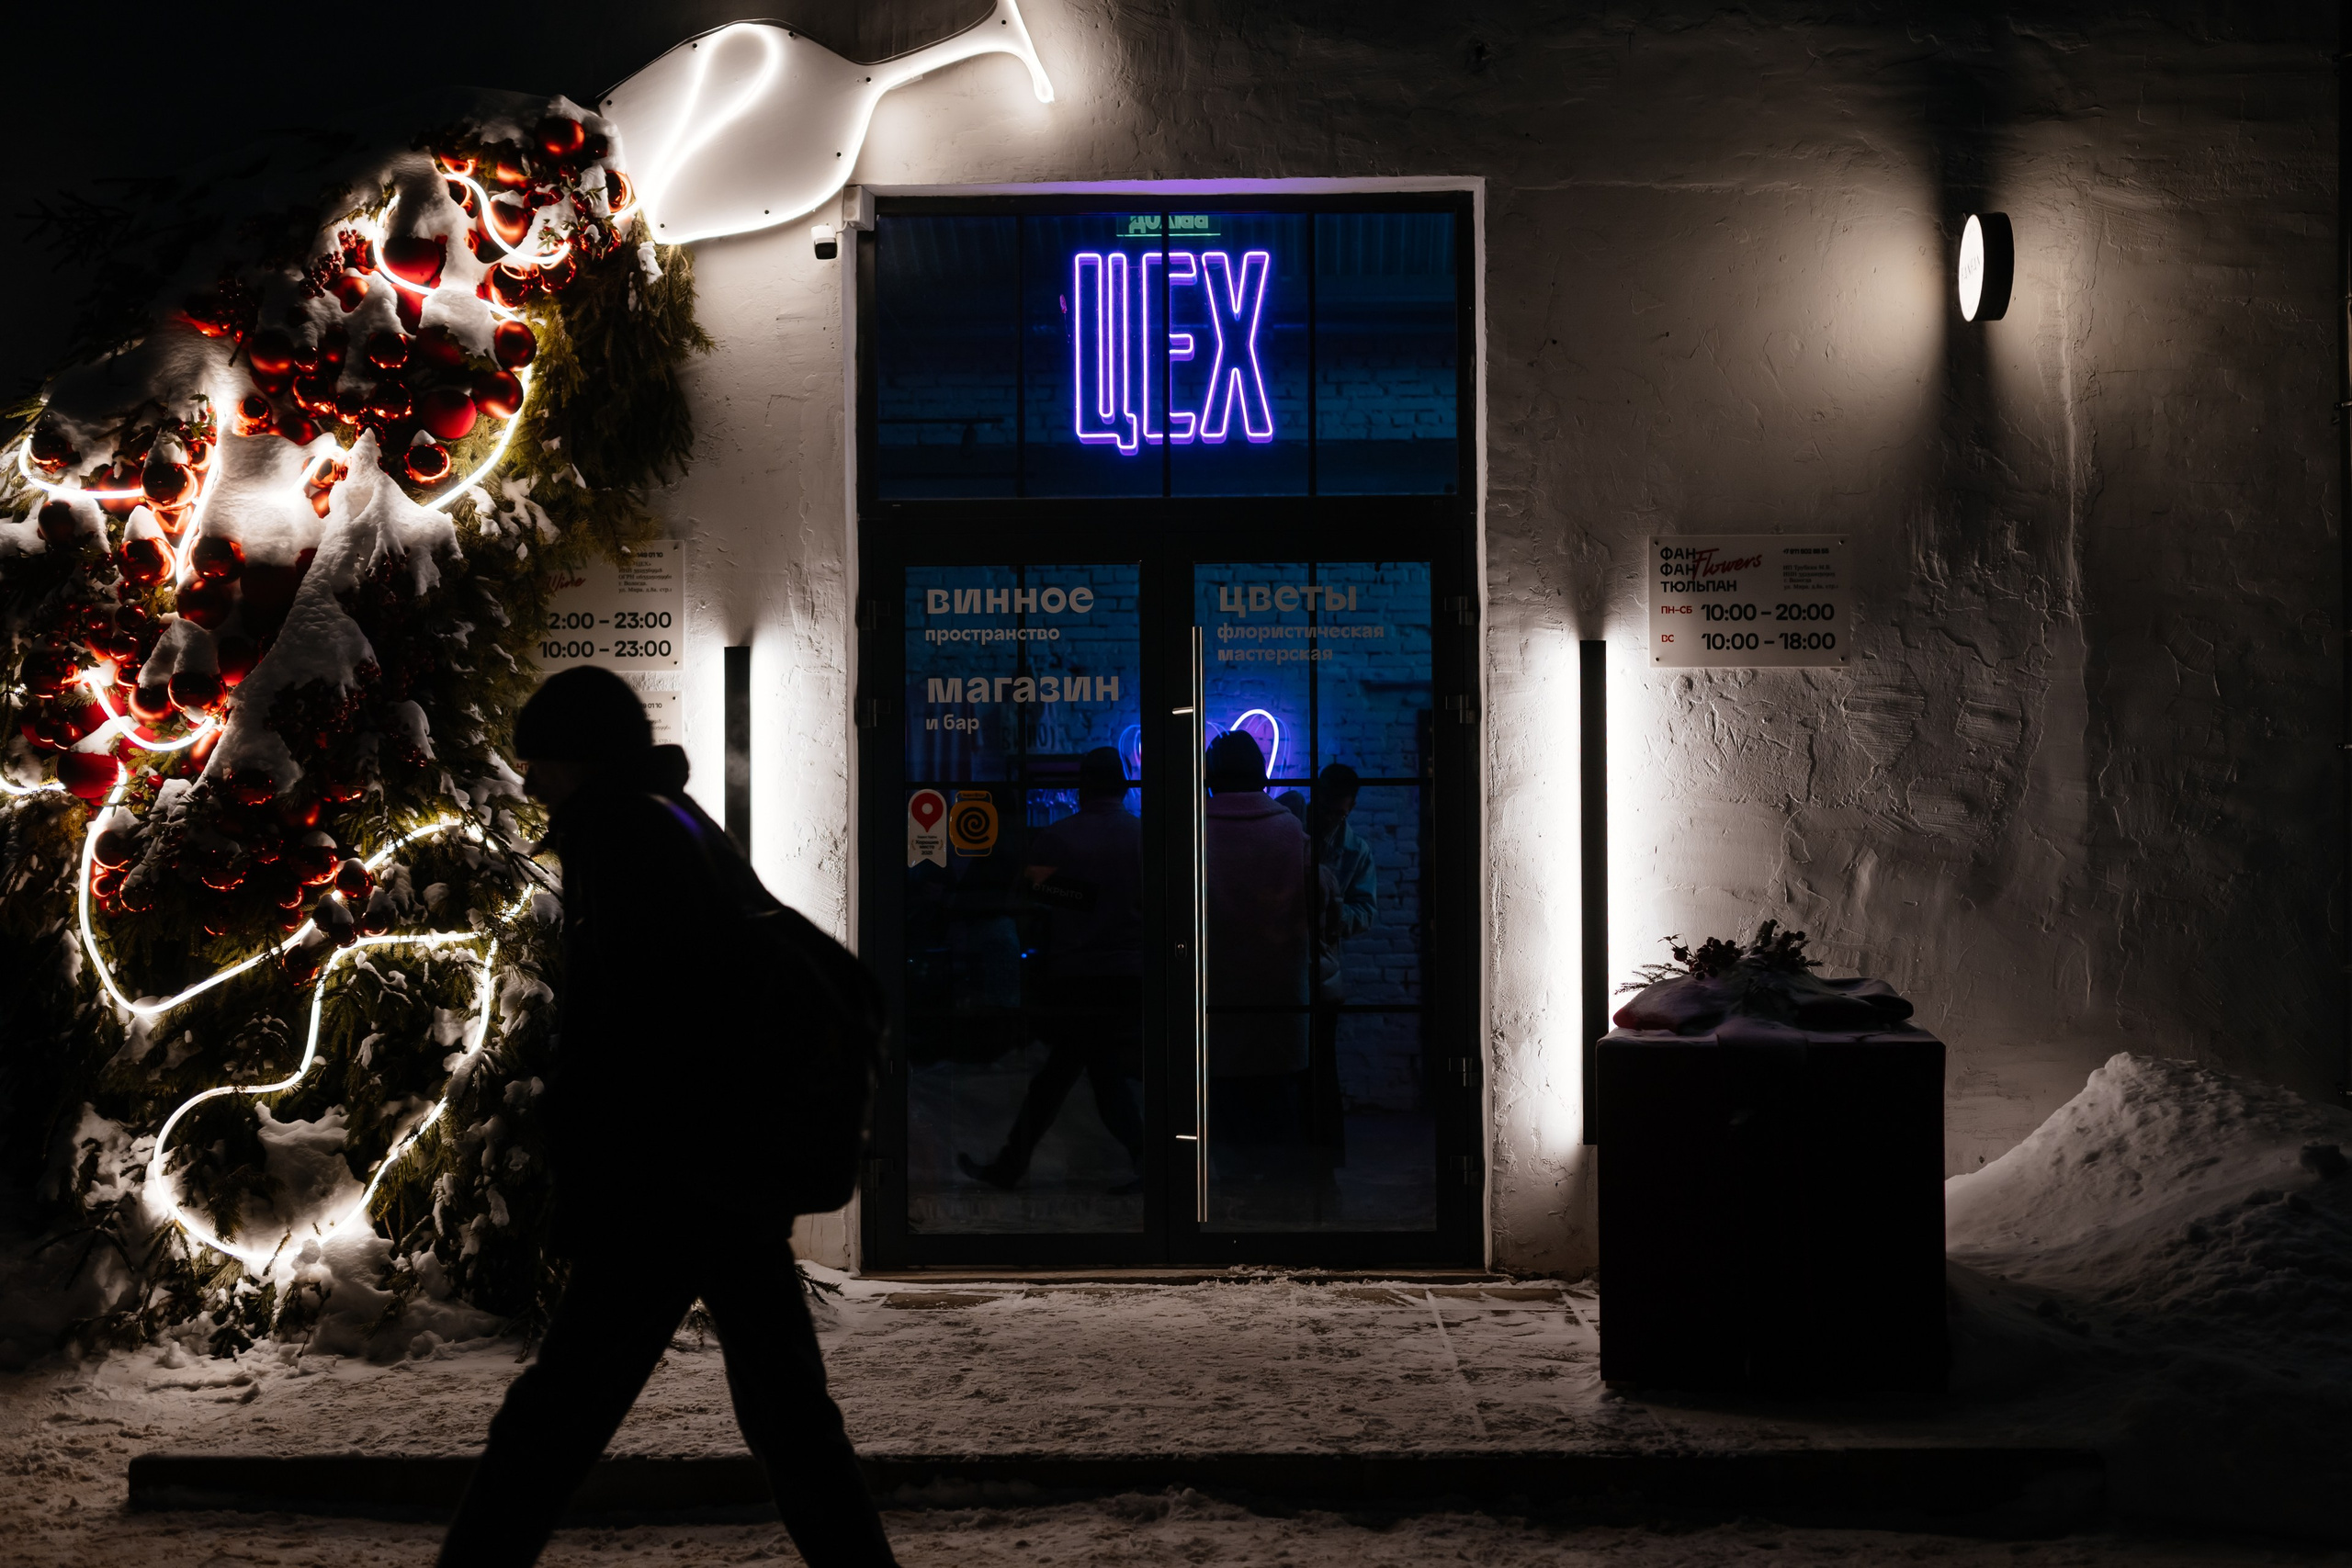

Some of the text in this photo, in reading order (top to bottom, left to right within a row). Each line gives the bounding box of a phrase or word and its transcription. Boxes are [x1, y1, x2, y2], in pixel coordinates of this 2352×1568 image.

[1074, 251, 1273, 453] ЦЕХ
[1660, 547, 1696, 561] ФАН
[1660, 562, 1696, 577] ФАН
[1692, 547, 1763, 581] Flowers
[1660, 581, 1736, 592] ТЮЛЬПАН
[927, 586, 1094, 615] винное
[1220, 586, 1357, 618] цветы
[548, 612, 594, 630] 2:00
[614, 612, 672, 628] 23:00
[1701, 604, 1757, 621] 10:00
[1775, 603, 1835, 621] 20:00
[924, 627, 1060, 646] пространство
[1216, 623, 1385, 643] флористическая
[1661, 634, 1674, 643] ВС
[1702, 632, 1758, 650] 10:00
[1779, 632, 1836, 650] 18:00
[538, 640, 594, 658] 10:00
[614, 640, 672, 658] 23:00
[1218, 647, 1333, 665] мастерская
[928, 676, 1119, 704] магазин
[926, 713, 979, 735] и бар
[1033, 882, 1084, 900] ОТКРЫТО
